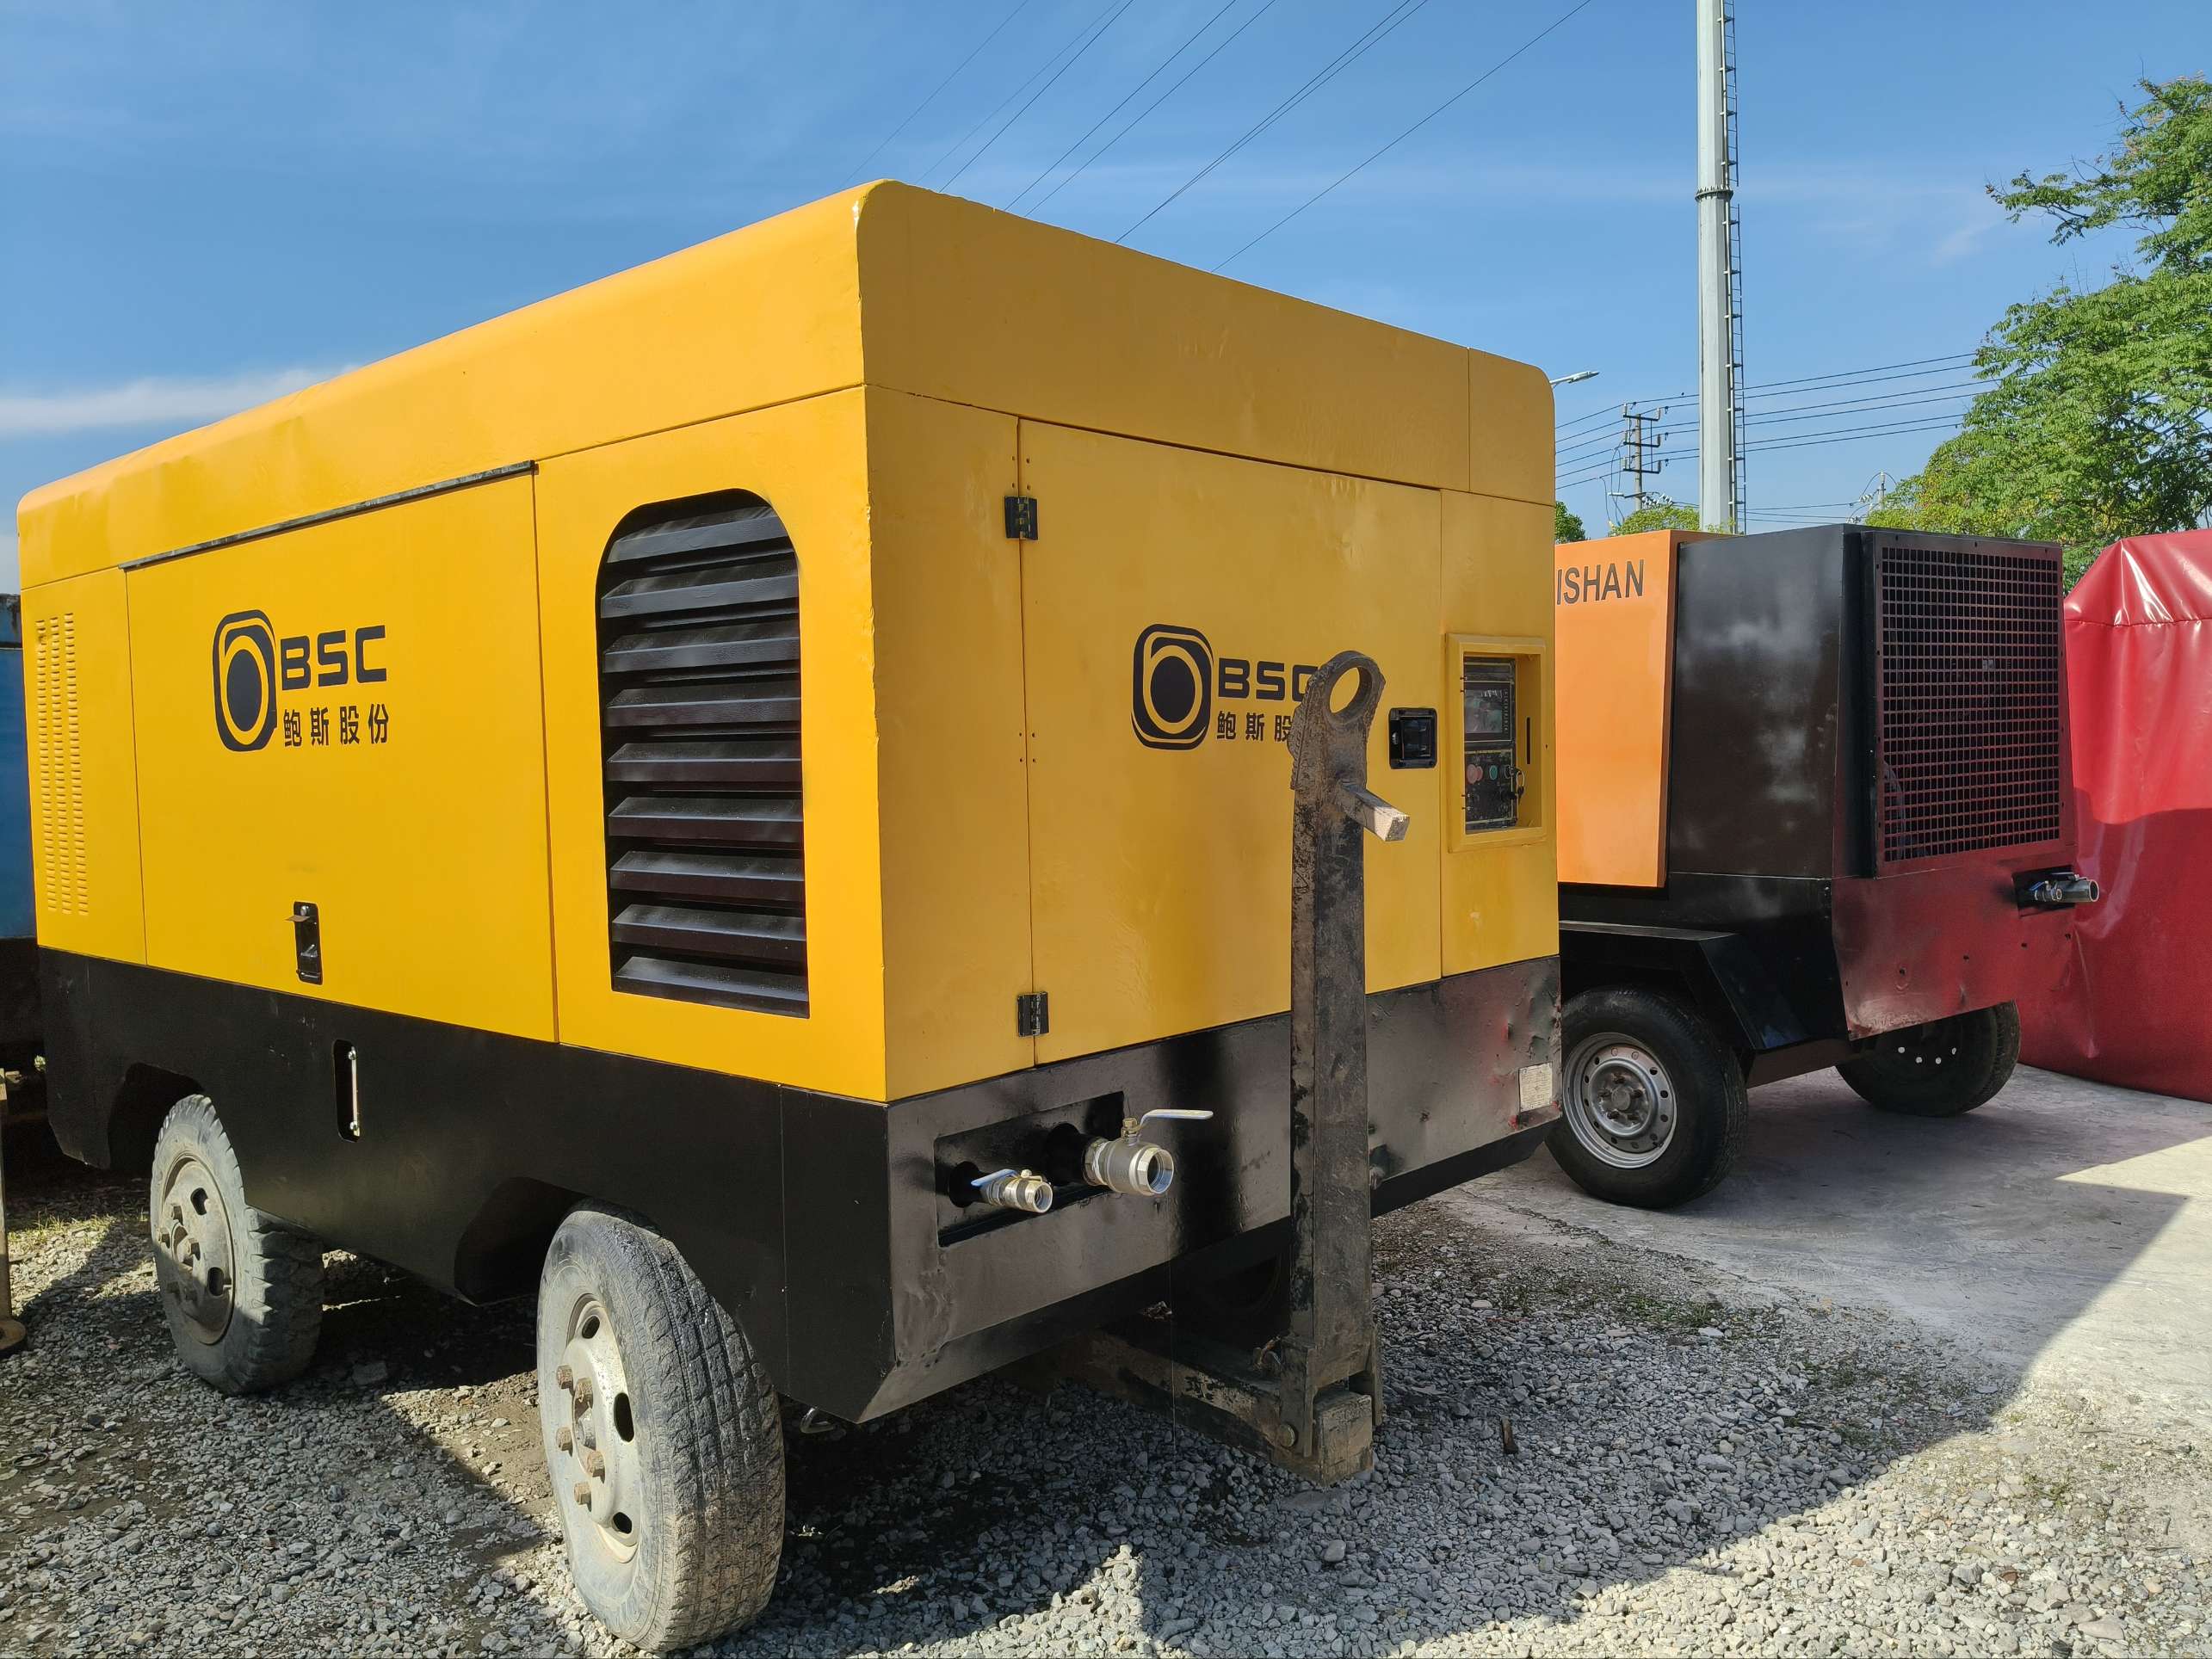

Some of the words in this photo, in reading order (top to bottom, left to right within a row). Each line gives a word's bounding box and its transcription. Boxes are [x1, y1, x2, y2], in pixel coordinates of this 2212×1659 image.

[1556, 559, 1645, 605] ISHAN
[280, 625, 387, 690] BSC
[283, 704, 388, 747] 鲍斯股份
